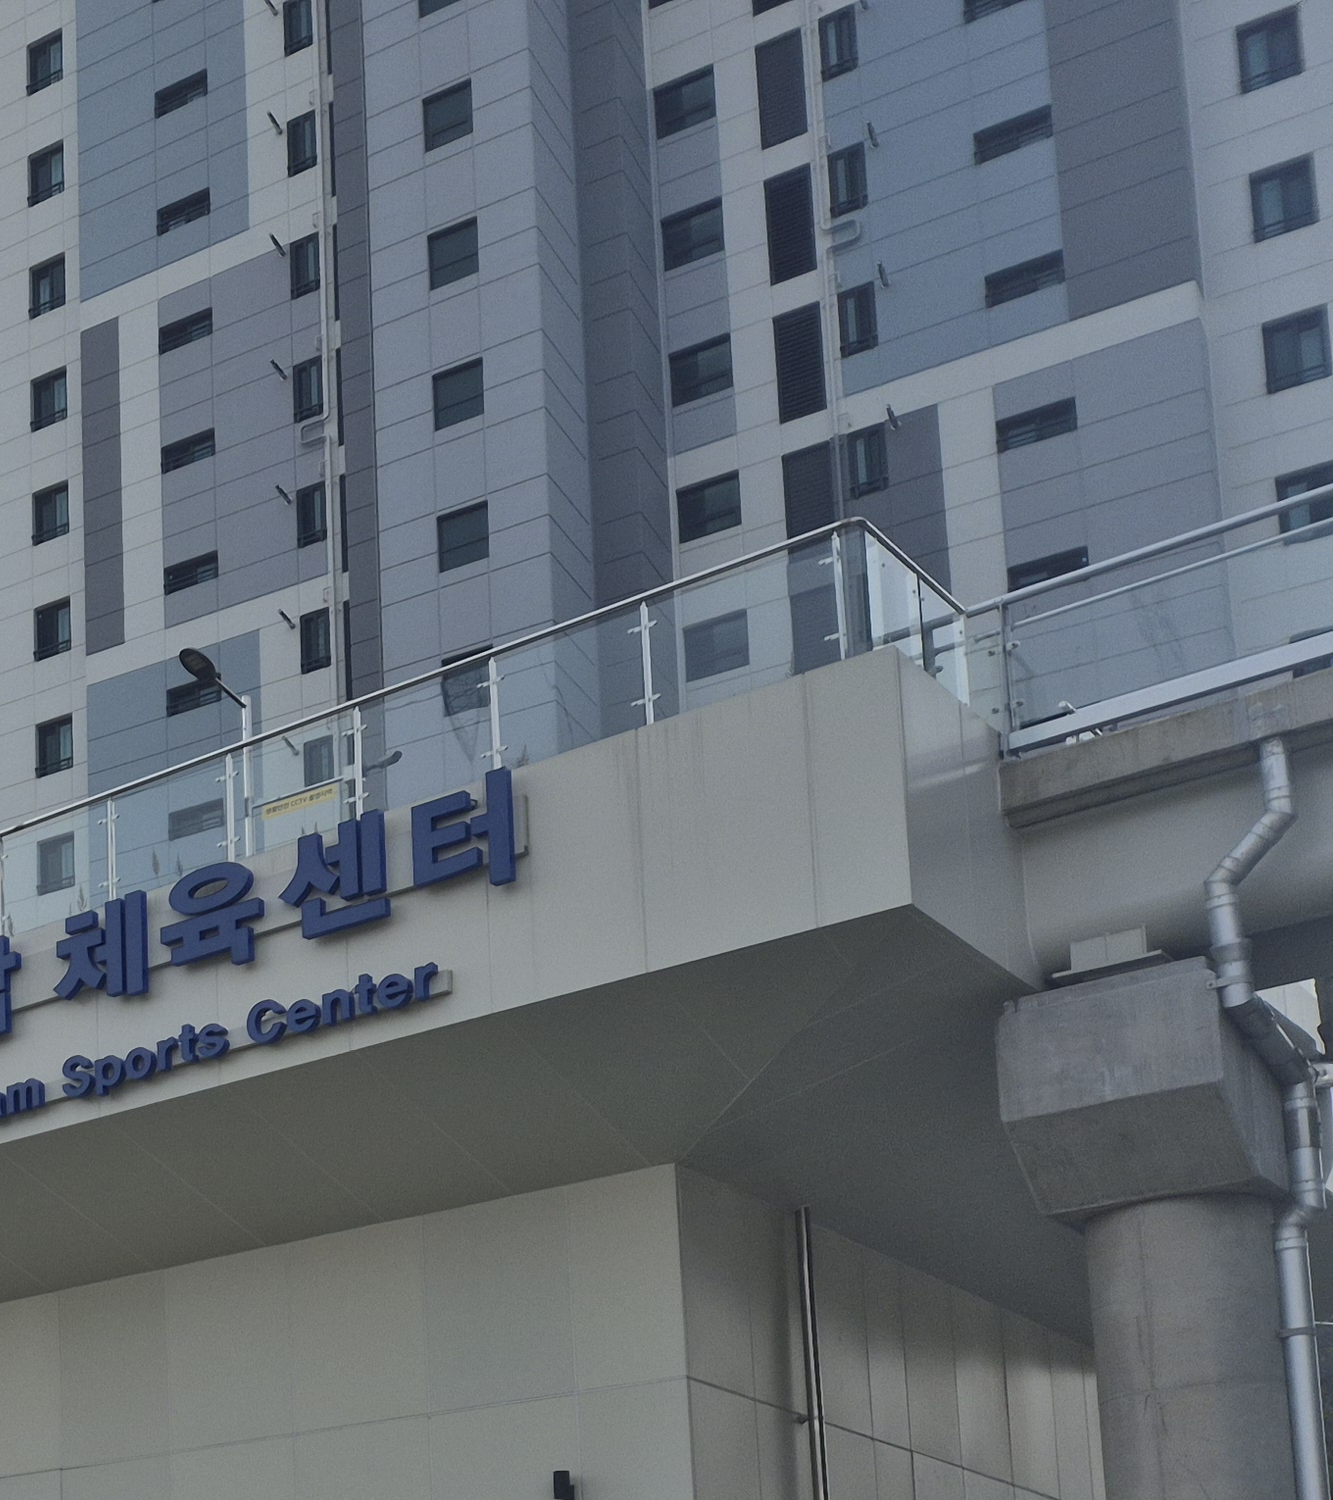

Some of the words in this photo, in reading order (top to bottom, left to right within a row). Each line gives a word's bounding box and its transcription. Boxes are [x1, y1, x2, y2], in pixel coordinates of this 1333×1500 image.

[54, 766, 517, 1000] 체육센터
[62, 1018, 230, 1098] Sports
[246, 961, 439, 1046] Center
